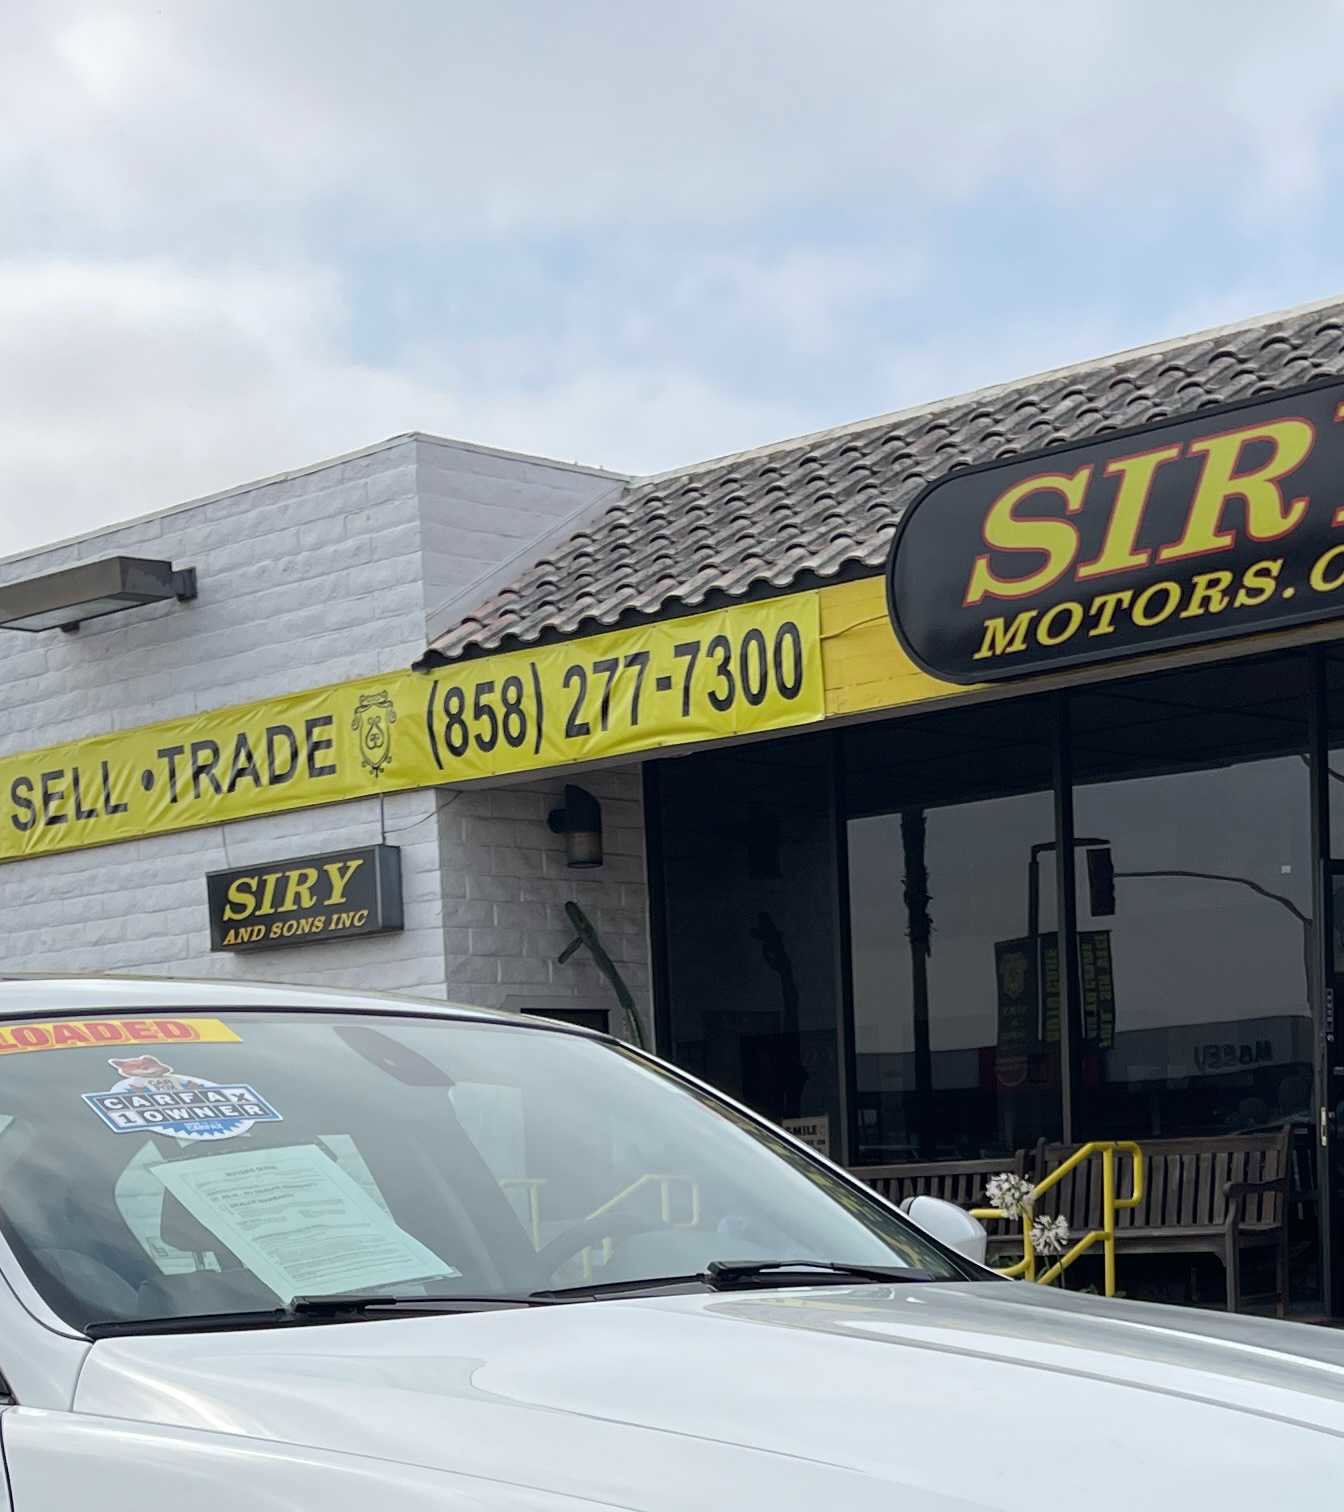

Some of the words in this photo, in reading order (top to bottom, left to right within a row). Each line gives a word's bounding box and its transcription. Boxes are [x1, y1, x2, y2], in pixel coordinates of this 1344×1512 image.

[426, 661, 544, 770] (858)
[562, 621, 804, 740] 277-7300
[10, 760, 128, 832] SELL
[157, 715, 337, 804] TRADE
[222, 859, 364, 922] SIRY
[222, 924, 265, 945] AND
[269, 916, 324, 938] SONS
[328, 909, 369, 930] INC
[104, 1091, 250, 1110] CARFAX
[143, 1104, 265, 1123] OWNER
